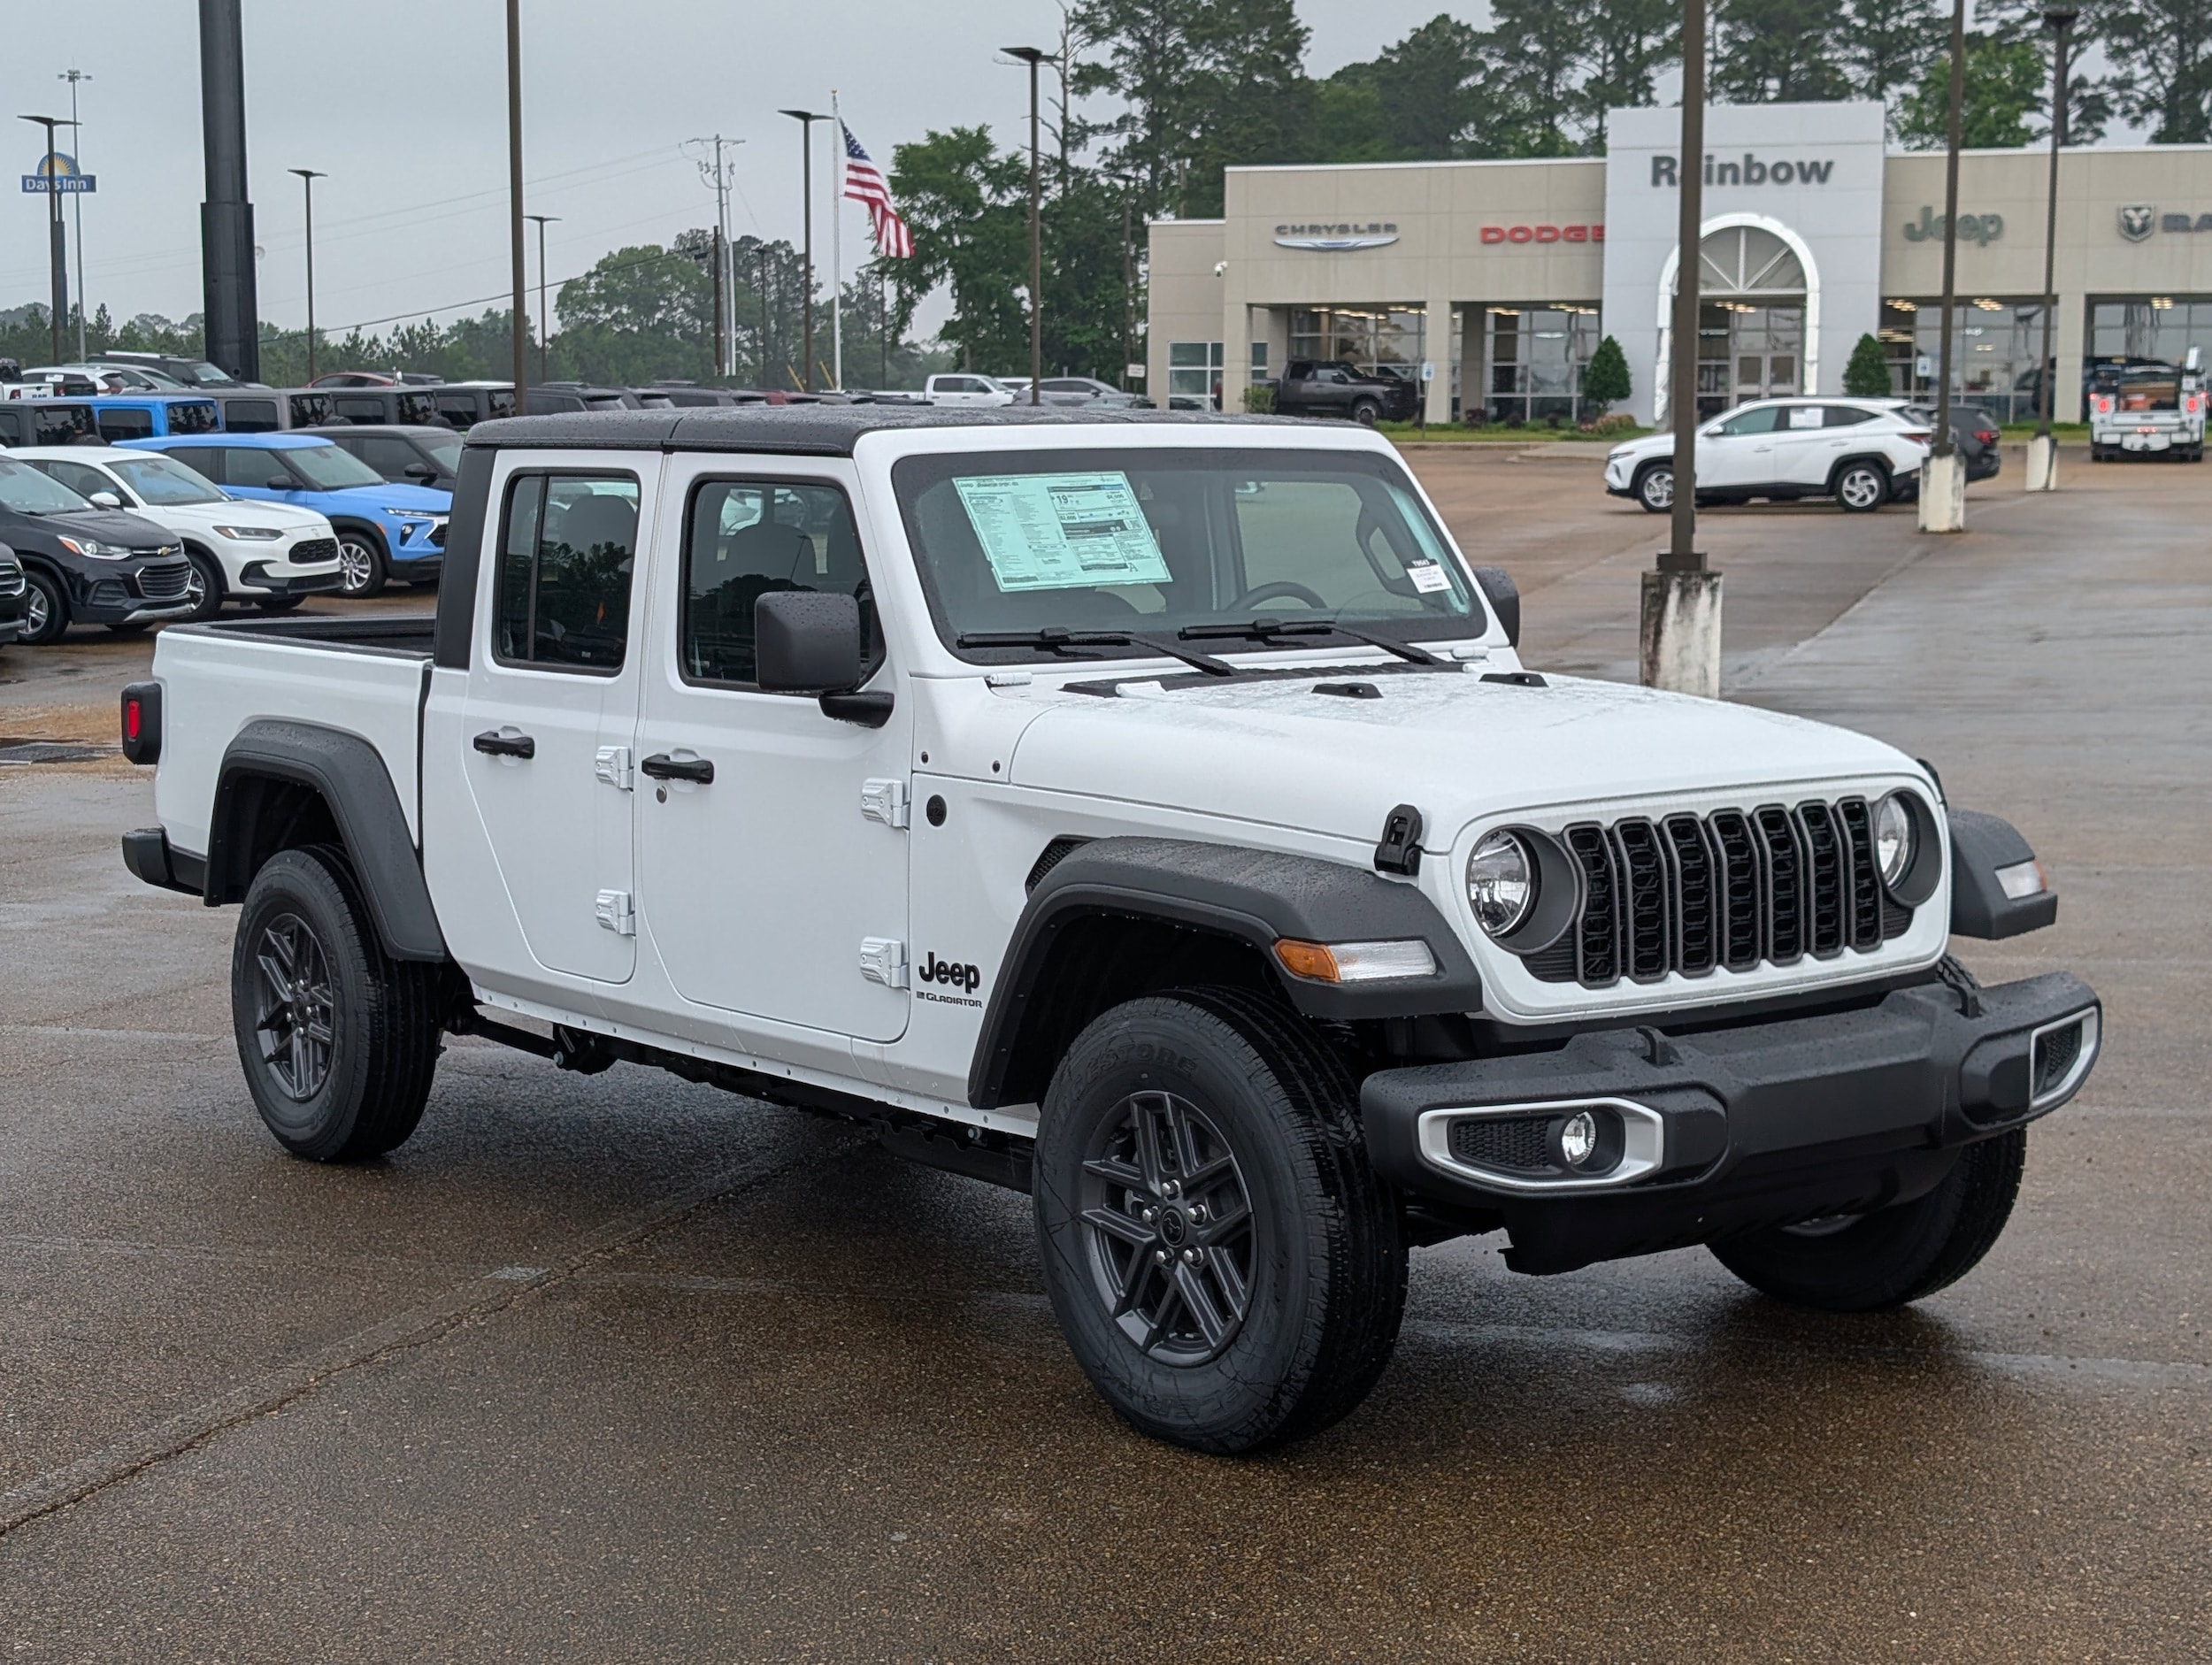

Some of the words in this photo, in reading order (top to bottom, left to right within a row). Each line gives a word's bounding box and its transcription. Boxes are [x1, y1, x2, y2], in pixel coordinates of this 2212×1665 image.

[1651, 153, 1834, 188] Rinbow
[63, 178, 87, 190] Inn
[1274, 223, 1398, 235] CHRYSLER
[1056, 495, 1069, 504] 19
[918, 951, 980, 994] Jeep
[926, 993, 983, 1009] GLADIATOR
